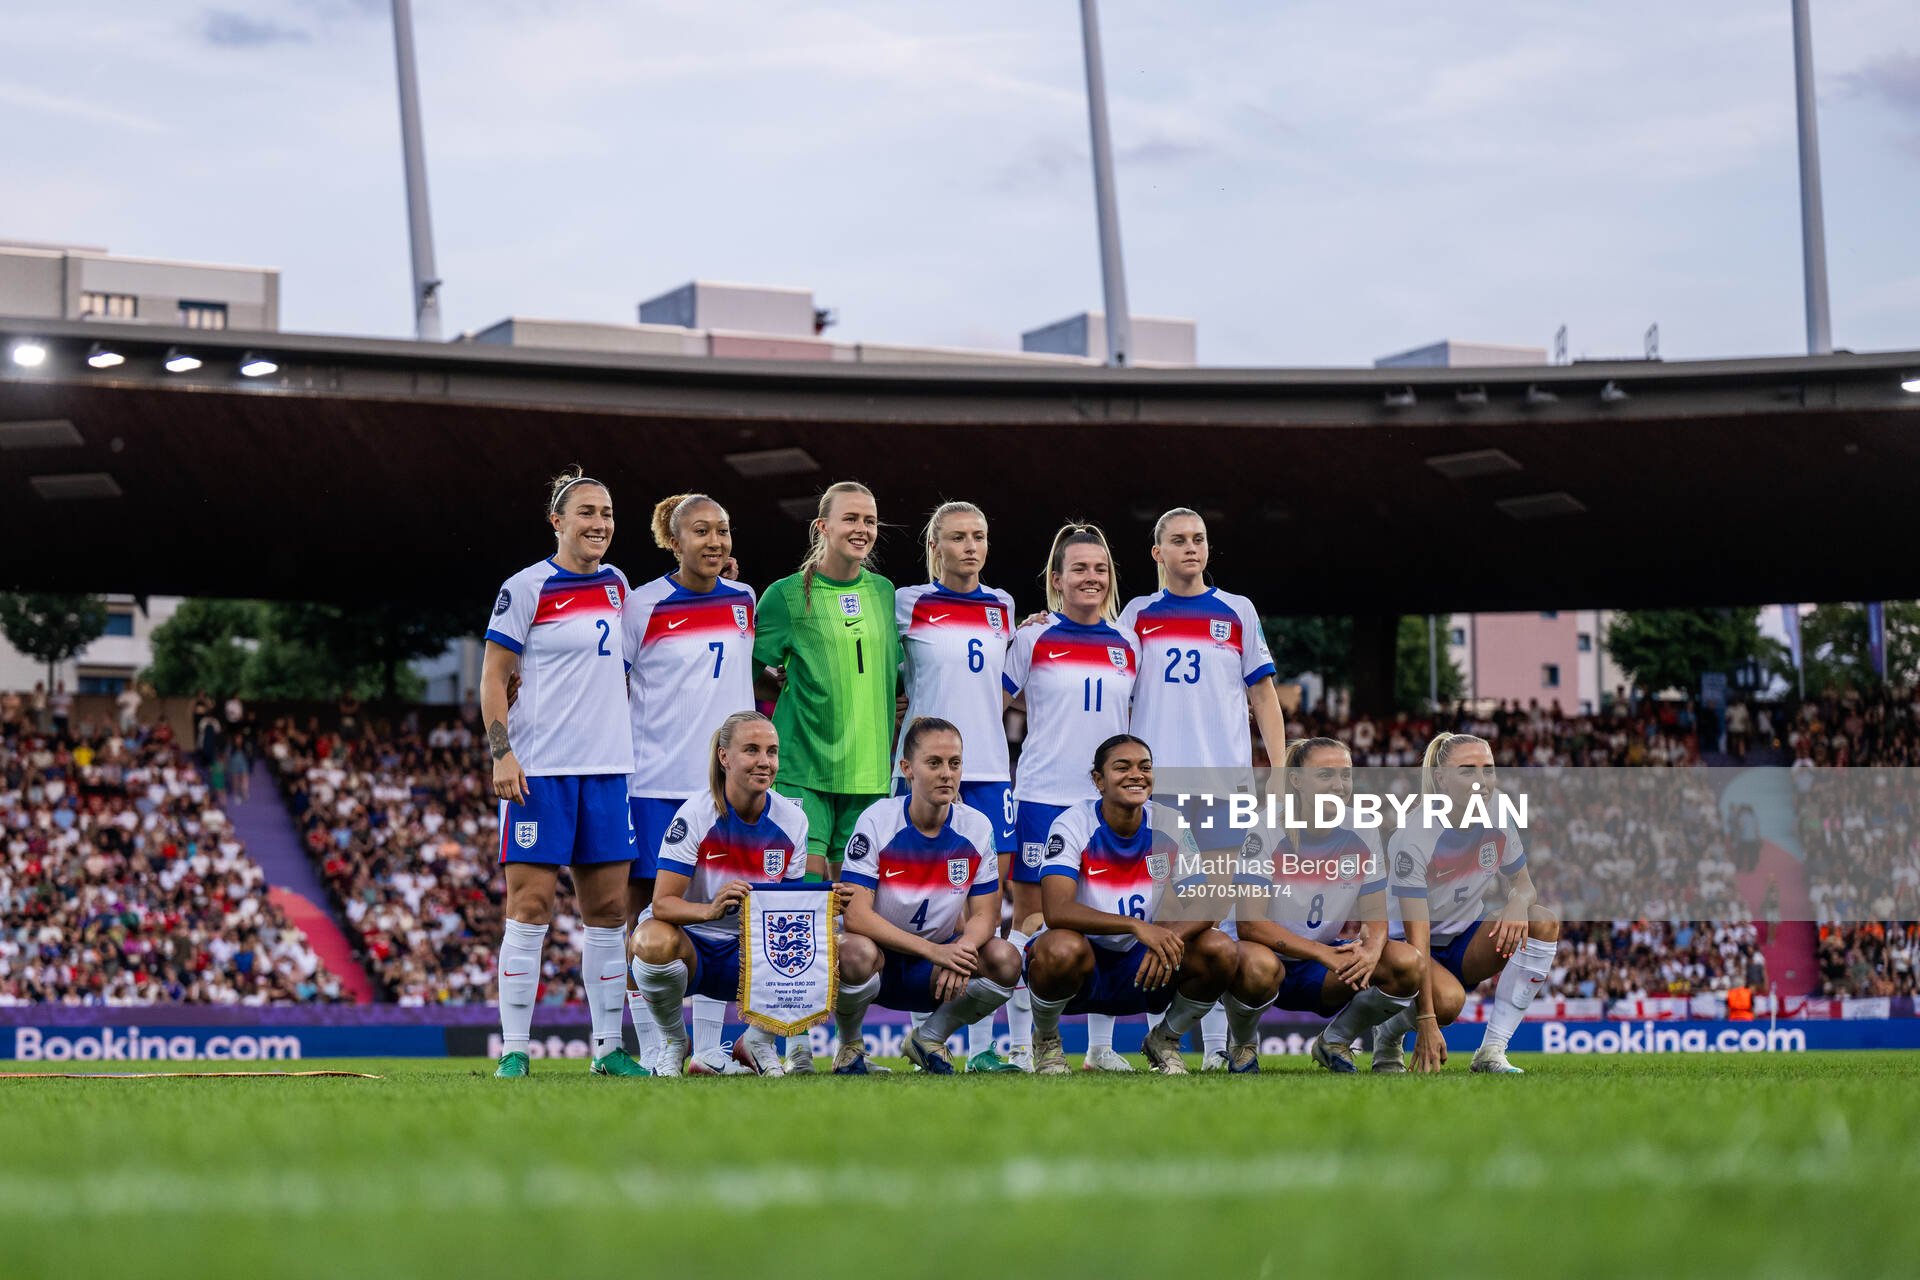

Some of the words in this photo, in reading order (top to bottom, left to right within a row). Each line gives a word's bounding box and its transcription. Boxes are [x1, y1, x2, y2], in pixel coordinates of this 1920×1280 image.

[596, 619, 611, 656] 2
[709, 642, 724, 678] 7
[856, 638, 864, 673] 1
[968, 638, 984, 673] 6
[1165, 648, 1200, 684] 23
[1084, 677, 1102, 712] 11
[1003, 788, 1014, 824] 6
[909, 898, 929, 931] 4
[1118, 894, 1145, 921] 16
[1307, 893, 1324, 929] 8
